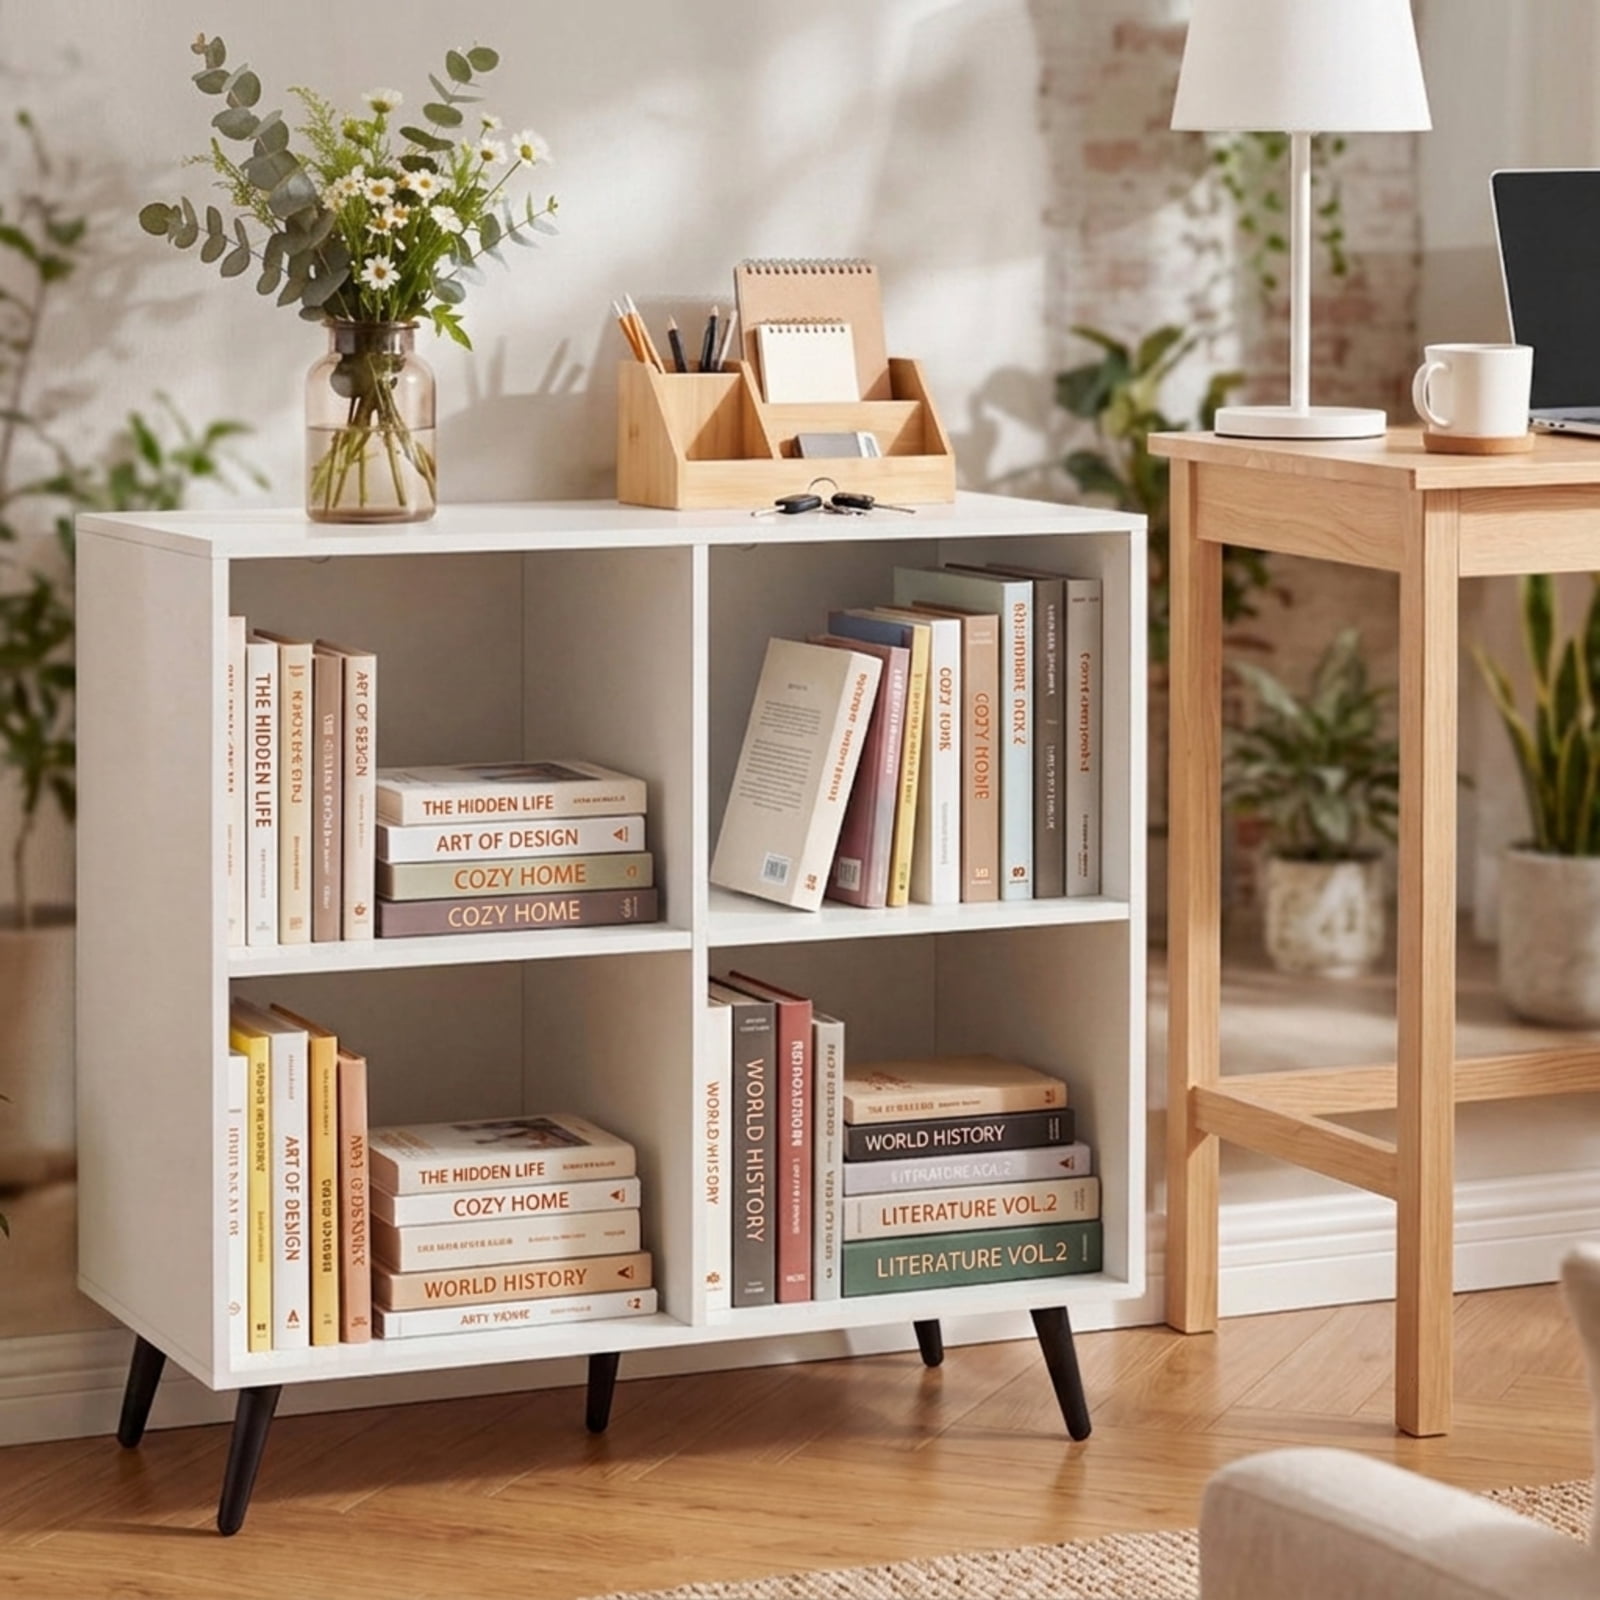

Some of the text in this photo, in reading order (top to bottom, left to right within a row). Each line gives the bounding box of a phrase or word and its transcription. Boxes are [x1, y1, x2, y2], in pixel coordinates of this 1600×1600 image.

[255, 673, 271, 709] THE
[255, 792, 272, 828] LIFE
[423, 800, 453, 816] THE
[457, 796, 518, 814] HIDDEN
[522, 795, 554, 811] LIFE
[436, 829, 579, 852] ART OF DESIGN
[454, 864, 586, 890] COZY HOME
[448, 900, 581, 928] COZY HOME
[285, 1136, 301, 1164] ART
[746, 1059, 765, 1243] WORLD HISTORY
[865, 1125, 1006, 1151] WORLD HISTORY
[284, 1171, 300, 1194] OF
[419, 1169, 449, 1185] THE
[452, 1165, 511, 1183] HIDDEN
[515, 1161, 546, 1179] LIFE
[453, 1191, 570, 1217] COZY HOME
[881, 1193, 1057, 1227] LITERATURE VOL.2
[877, 1247, 1003, 1279] LITERATURE
[424, 1268, 588, 1299] WORLD HISTORY
